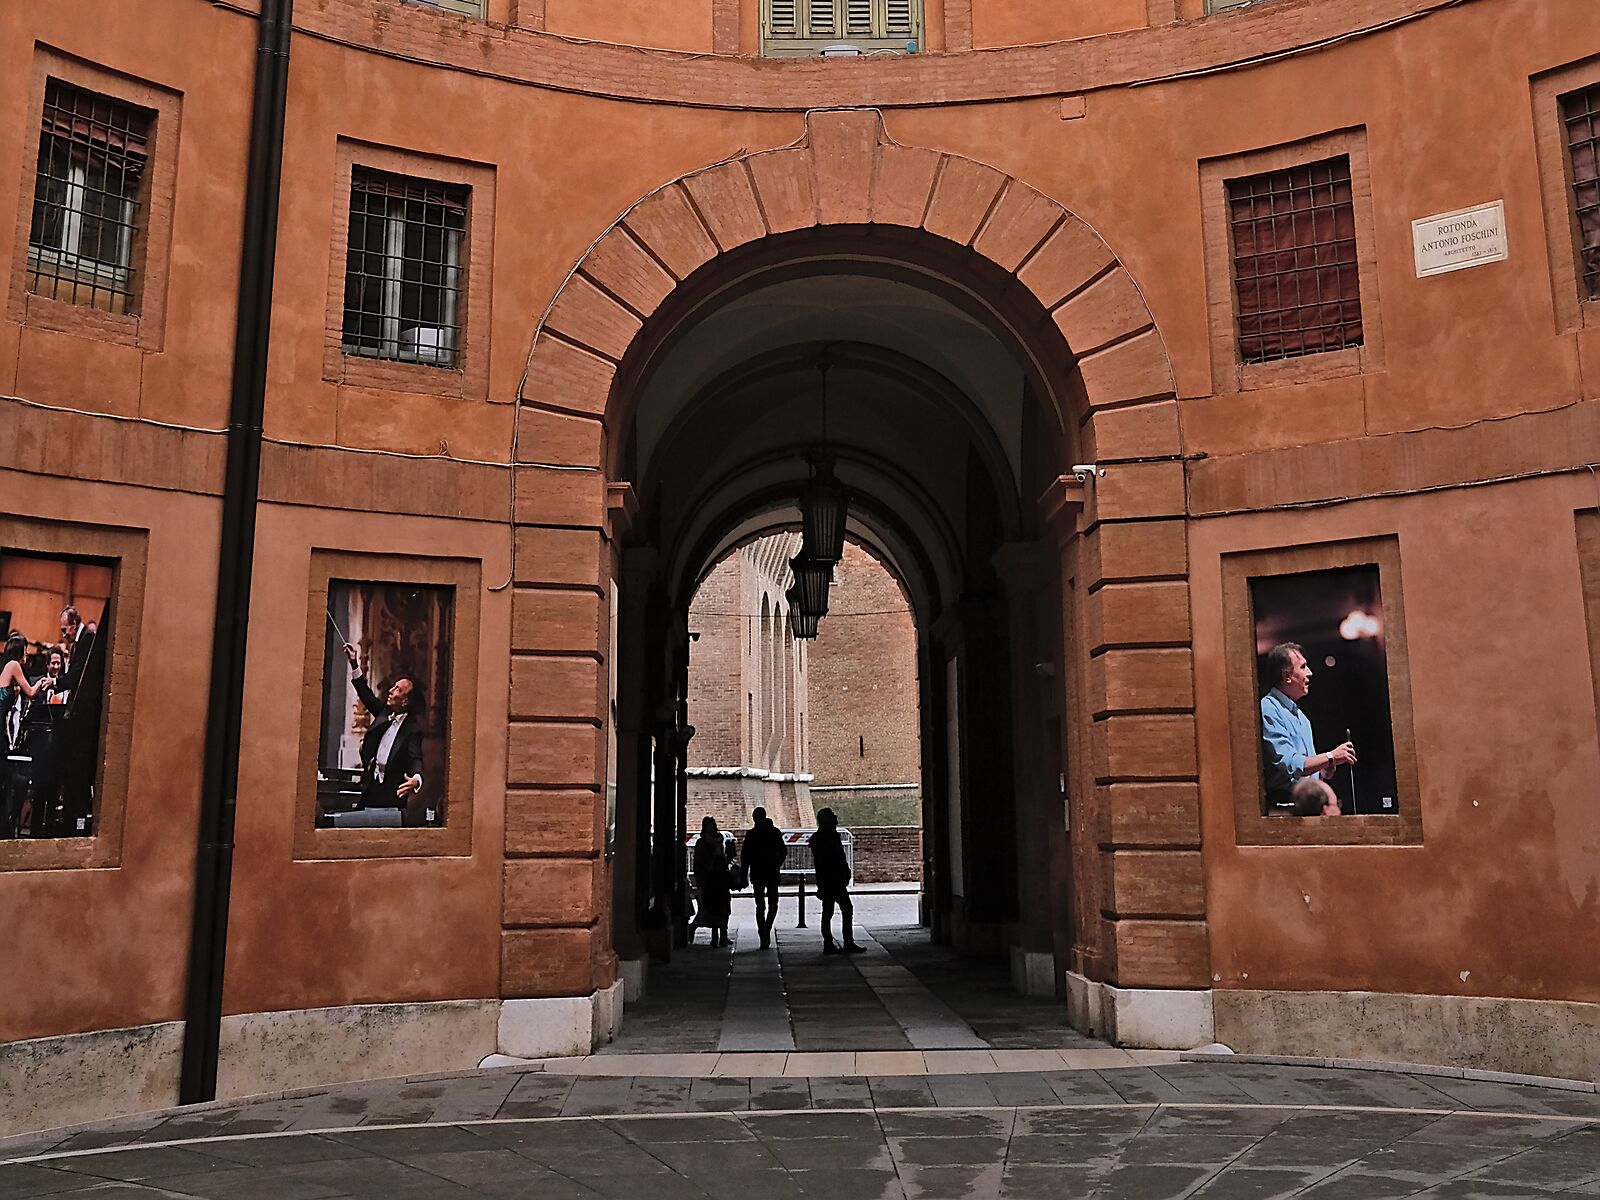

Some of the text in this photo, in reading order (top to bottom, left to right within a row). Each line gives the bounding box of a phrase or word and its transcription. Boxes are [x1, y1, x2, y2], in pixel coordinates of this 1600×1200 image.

[1438, 220, 1478, 235] ROTONDA
[1421, 227, 1498, 253] ANTONIO FOSCHINI
[1444, 245, 1476, 256] ARCHITETTO
